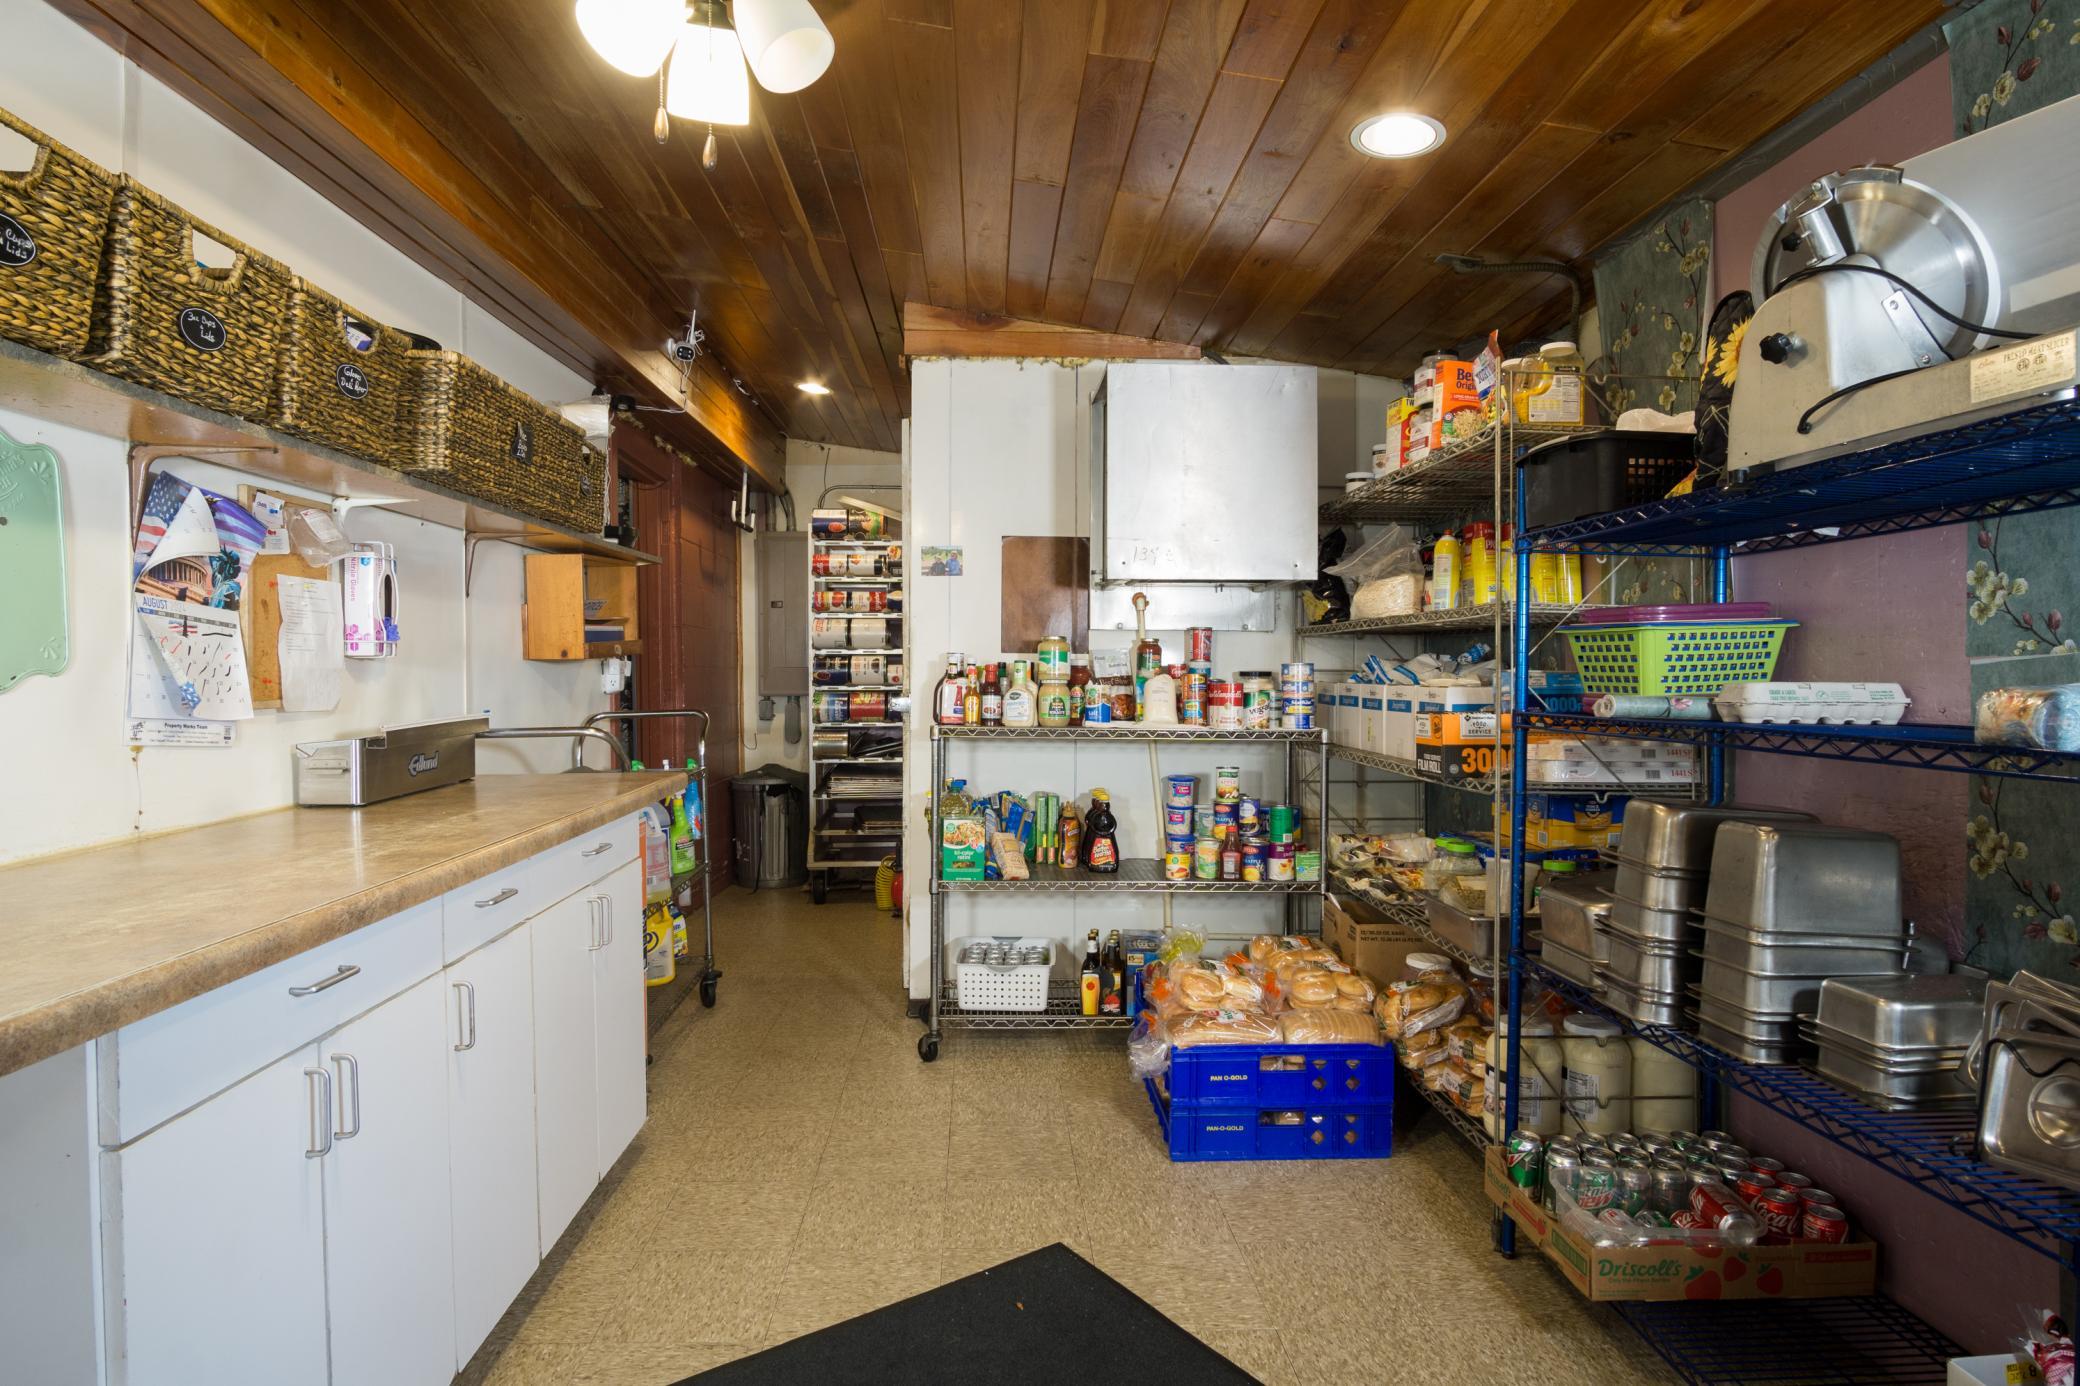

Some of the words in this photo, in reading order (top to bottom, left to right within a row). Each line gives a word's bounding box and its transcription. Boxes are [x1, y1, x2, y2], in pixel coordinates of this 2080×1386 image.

[1457, 368, 1474, 381] Be
[350, 557, 358, 579] Nitrile
[143, 596, 168, 609] AUGUST
[408, 750, 440, 776] Edlund
[1598, 1258, 1683, 1277] Driscoll's
